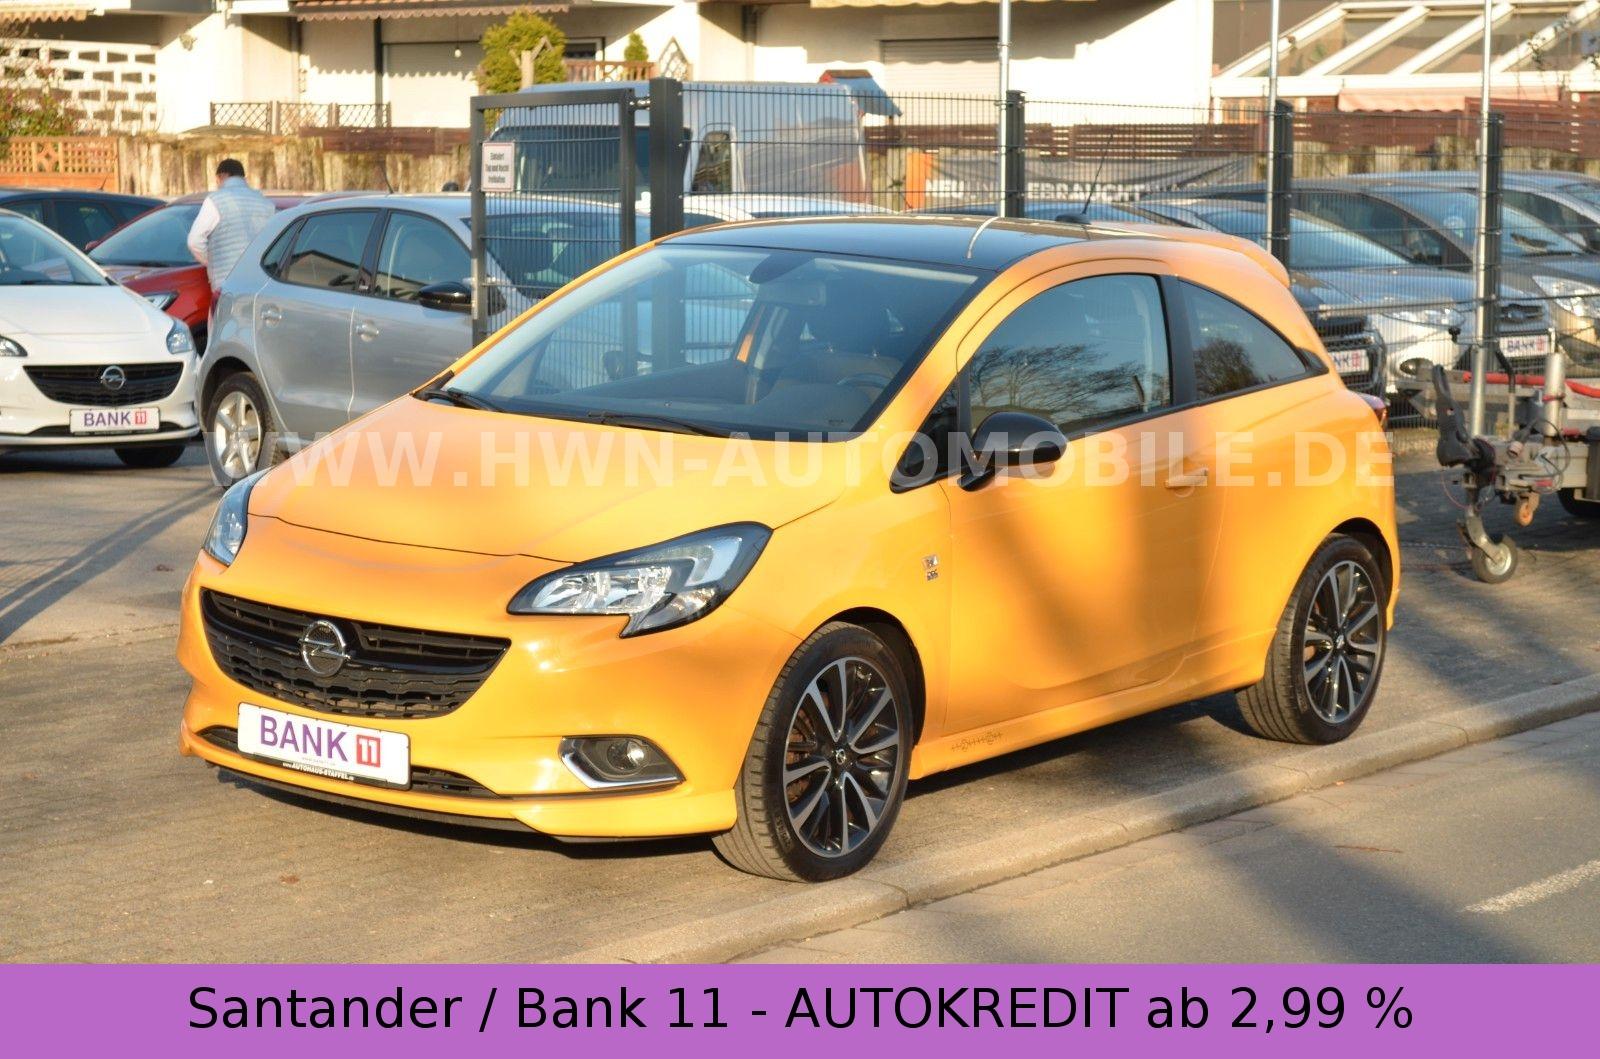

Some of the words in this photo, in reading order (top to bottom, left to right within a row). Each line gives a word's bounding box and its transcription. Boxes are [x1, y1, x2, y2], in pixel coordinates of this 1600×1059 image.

[1026, 181, 1144, 203] EBRAUCHT
[83, 411, 131, 427] BANK
[260, 714, 349, 762] BANK
[357, 735, 380, 767] 11
